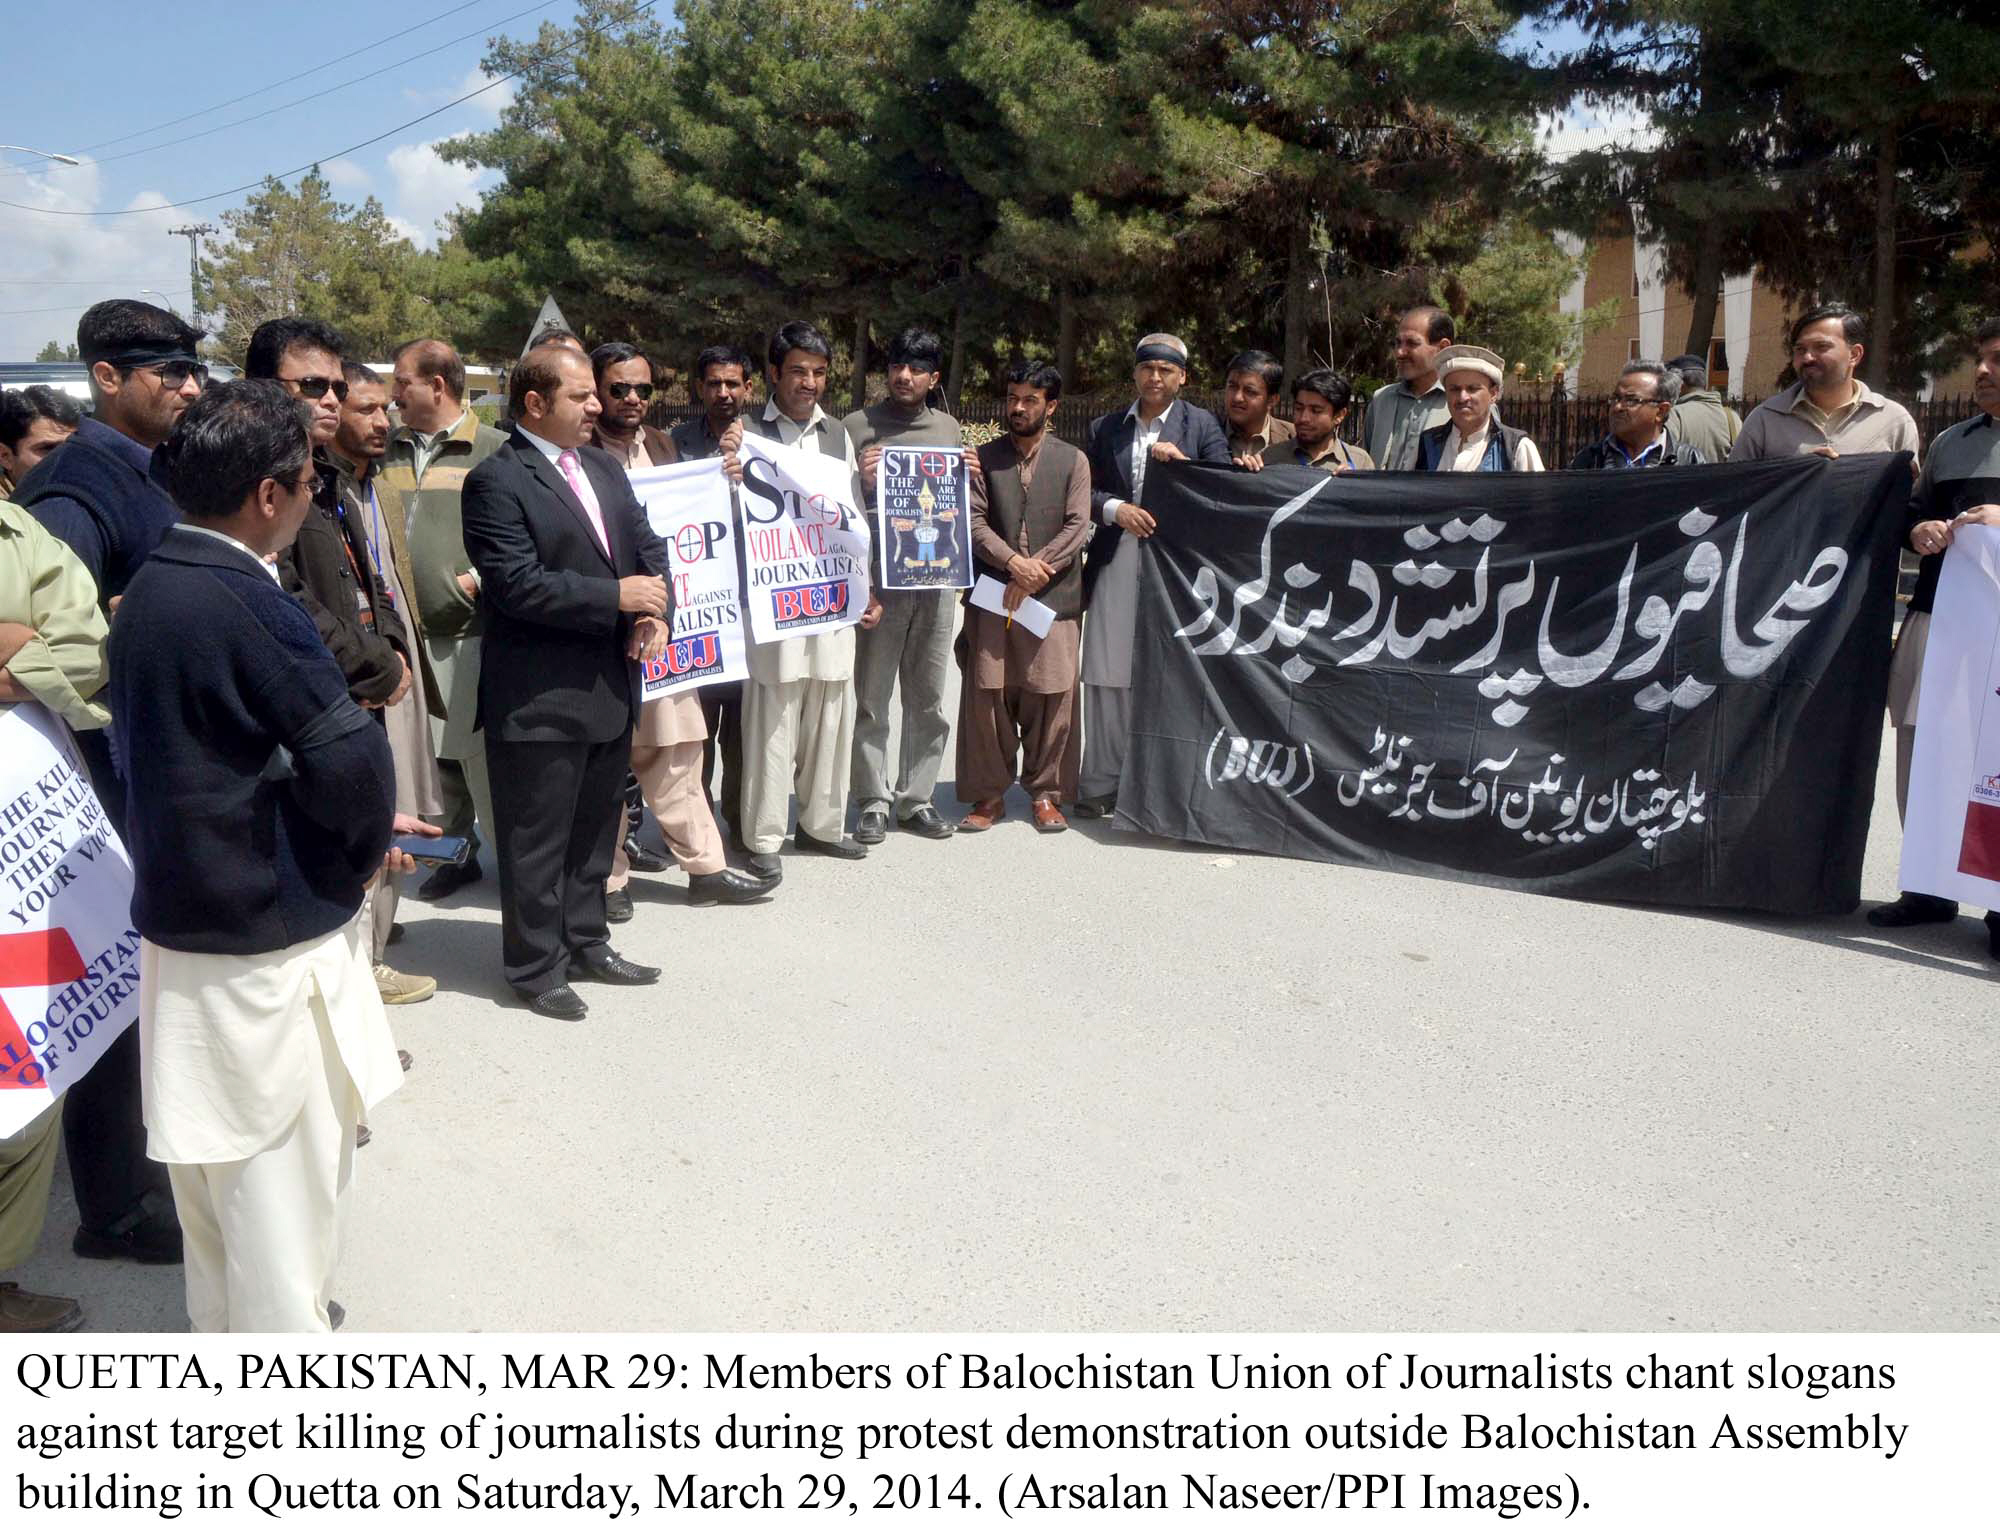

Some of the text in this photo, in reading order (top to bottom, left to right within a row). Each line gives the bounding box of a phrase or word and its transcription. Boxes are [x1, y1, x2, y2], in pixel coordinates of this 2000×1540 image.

[885, 451, 960, 478] STOP
[889, 477, 915, 488] THE
[936, 476, 958, 486] THEY
[743, 456, 857, 532] STOP
[885, 488, 921, 496] KILLING
[893, 497, 911, 508] OF
[937, 494, 957, 502] YOUR
[938, 485, 956, 495] ARE
[748, 523, 827, 563] VOILANCE
[691, 589, 732, 606] AGAINST
[771, 582, 847, 622] BUJ
[1232, 562, 1334, 684] بند
[645, 634, 719, 682] BUJ
[1450, 560, 1544, 727] پر
[6, 795, 101, 893] THEY ARE
[8, 864, 77, 927] YOUR
[18, 1044, 60, 1085] OF
